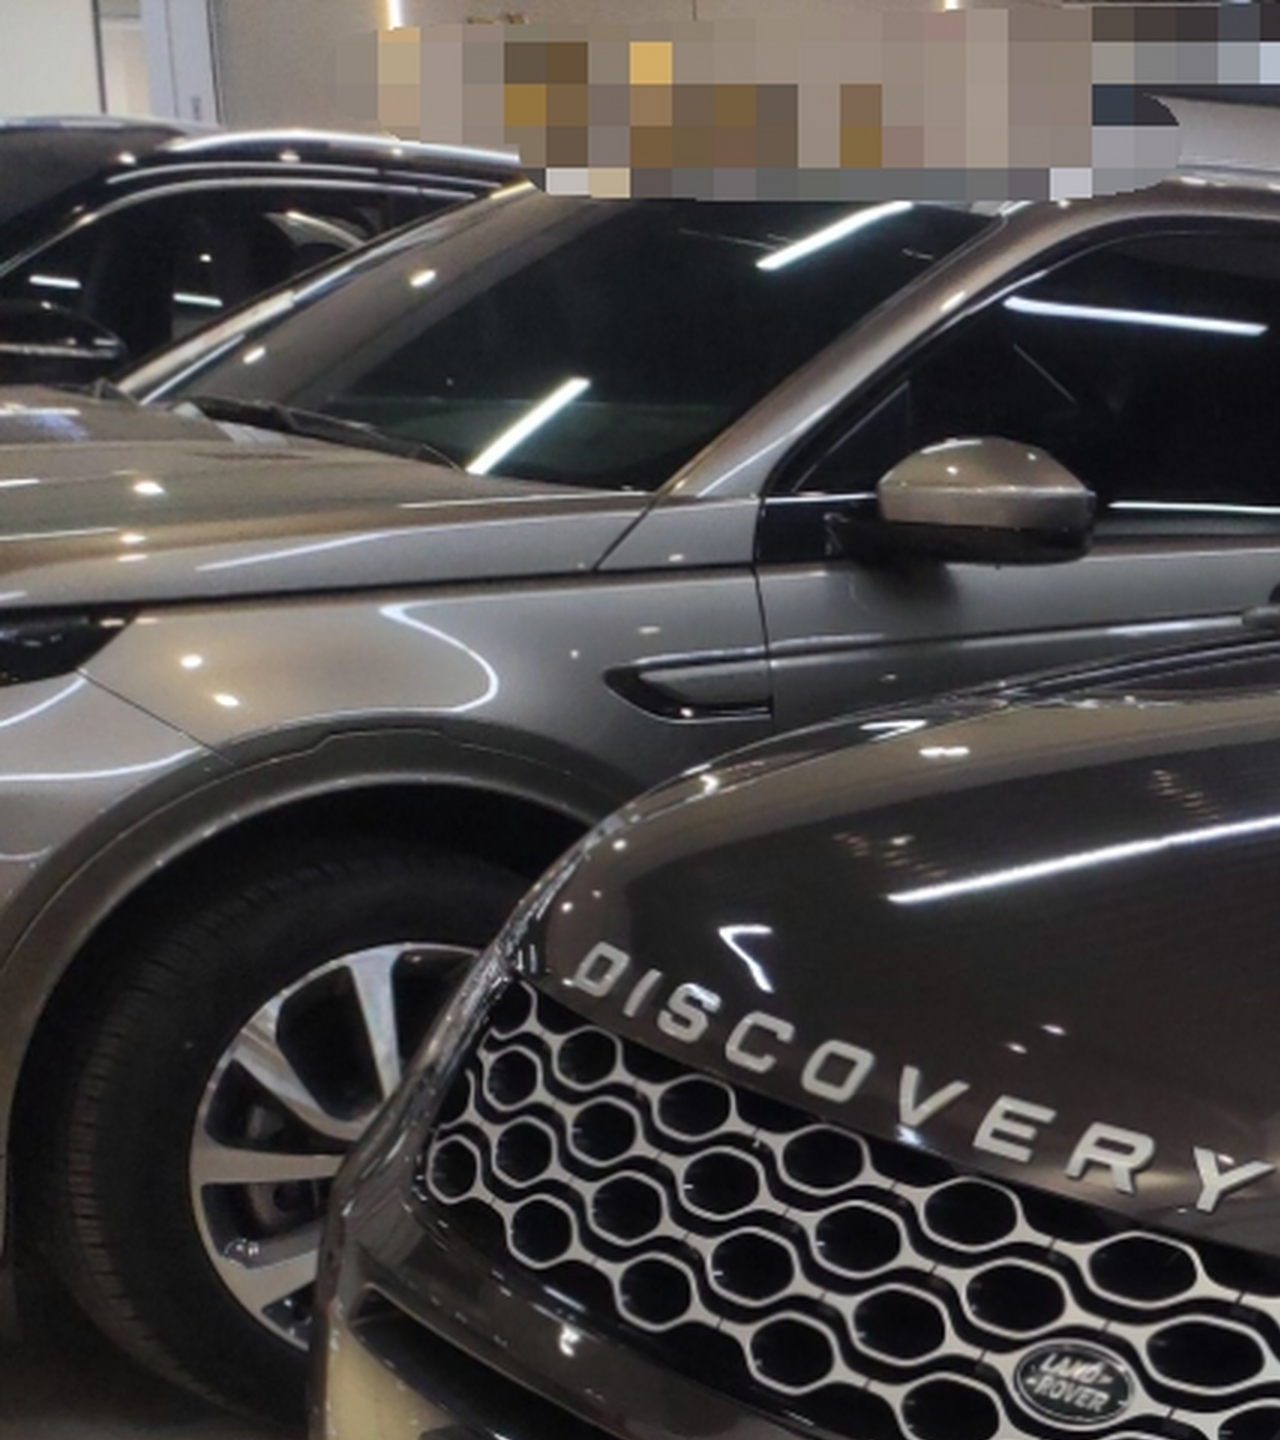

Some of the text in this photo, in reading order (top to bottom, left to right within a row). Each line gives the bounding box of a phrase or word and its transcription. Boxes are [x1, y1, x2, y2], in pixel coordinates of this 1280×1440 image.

[573, 941, 1275, 1213] DISCOVERY
[1040, 1353, 1104, 1384] LAND
[1034, 1375, 1110, 1413] ROVER
